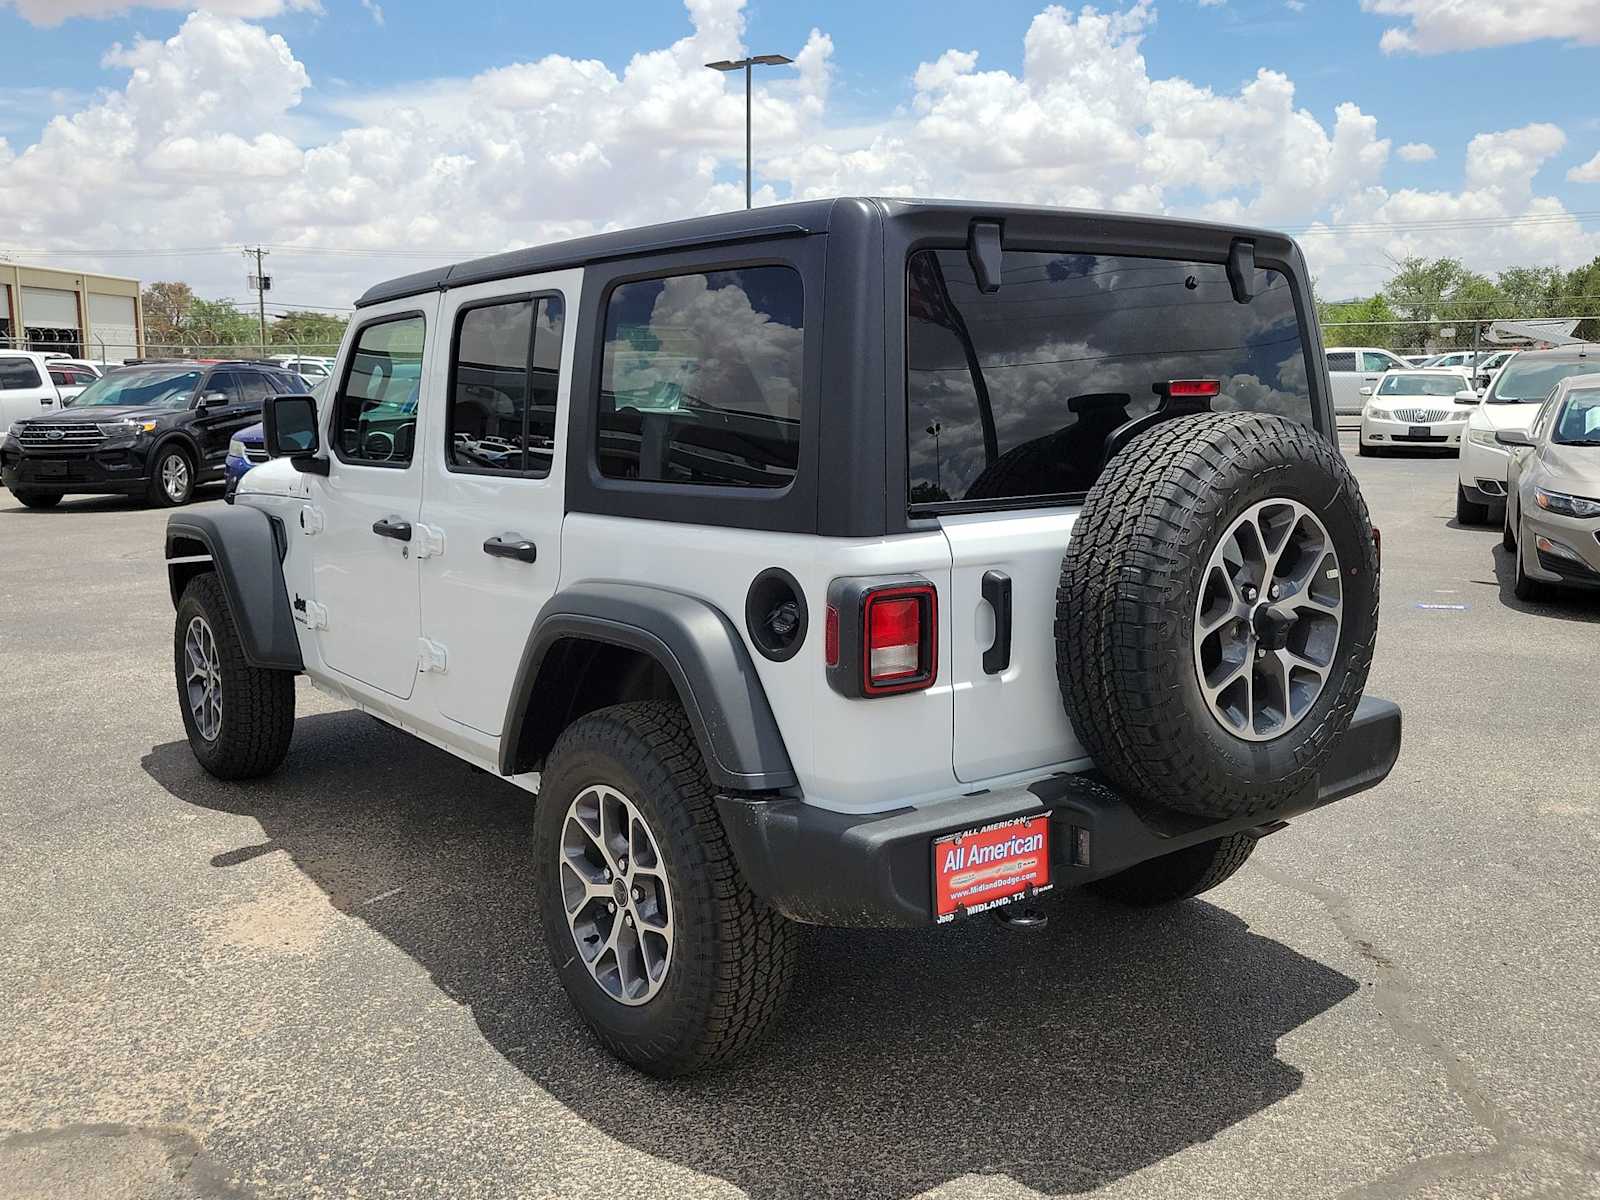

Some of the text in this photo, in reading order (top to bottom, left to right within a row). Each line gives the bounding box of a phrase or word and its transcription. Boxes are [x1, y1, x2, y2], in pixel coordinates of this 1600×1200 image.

[961, 829, 979, 839] ALL
[944, 848, 964, 873] All
[967, 833, 1043, 868] American
[950, 871, 1037, 900] www.MidlandDodge.com
[966, 891, 1025, 915] MIDLAND, TX
